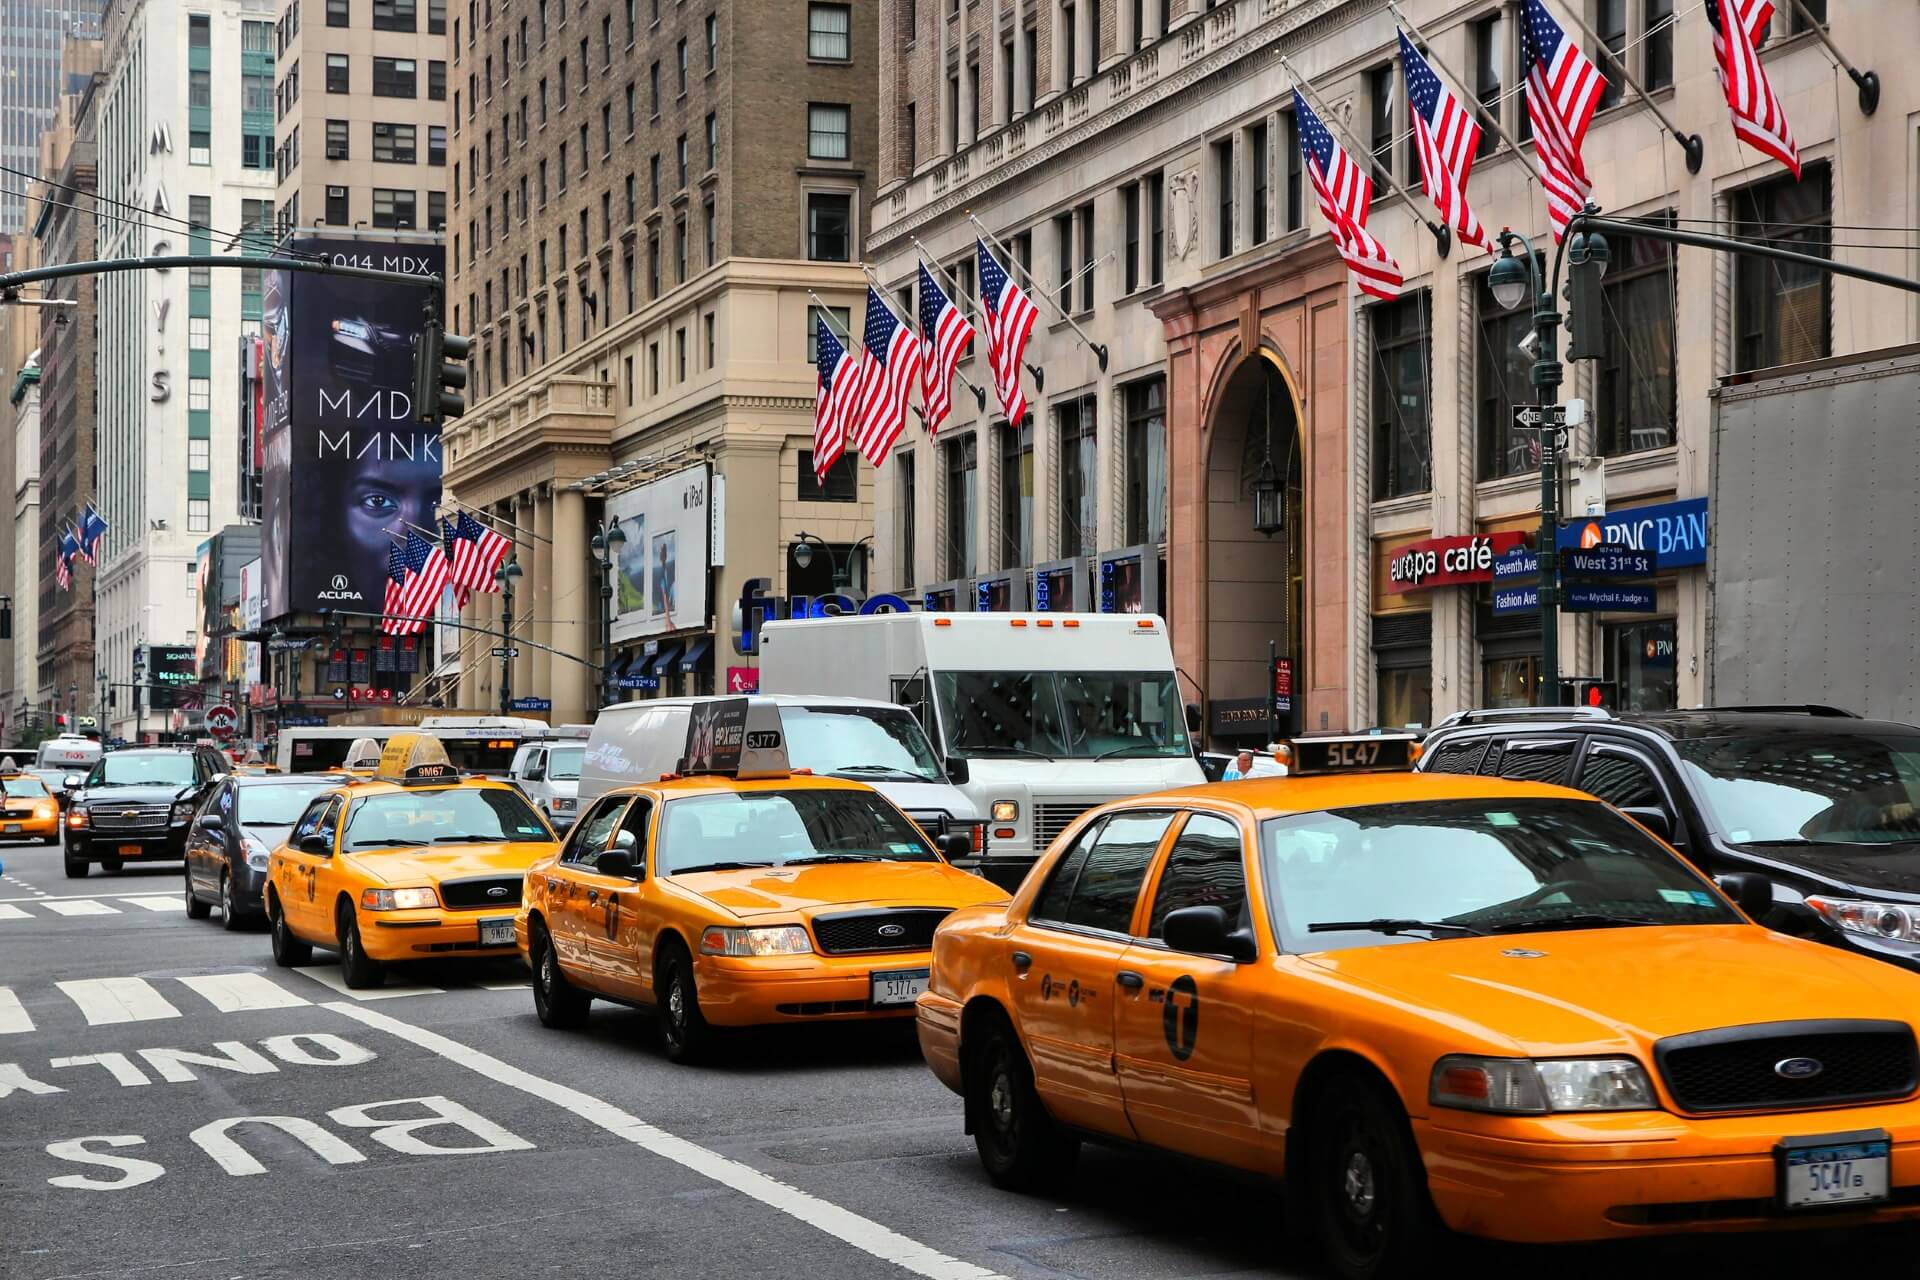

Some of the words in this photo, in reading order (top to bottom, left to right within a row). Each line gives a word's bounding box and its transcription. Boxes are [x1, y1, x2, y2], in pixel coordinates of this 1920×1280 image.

[321, 253, 373, 269] 014
[383, 256, 430, 274] MDX
[319, 388, 411, 420] MAD
[1522, 412, 1540, 421] ONE
[318, 430, 438, 463] MANK
[689, 481, 703, 509] iPad
[1656, 511, 1708, 554] BAN
[1391, 550, 1436, 585] europa
[1444, 537, 1492, 572] café
[1495, 557, 1523, 575] Seventh
[1523, 557, 1537, 571] Ave
[1574, 555, 1606, 570] West
[1609, 556, 1632, 571] 31st
[1634, 556, 1649, 571] St
[317, 591, 363, 600] ACURA
[1496, 592, 1522, 609] Fashion
[1523, 593, 1537, 605] Ave
[1589, 593, 1614, 603] Mychal
[1622, 594, 1642, 604] Judge
[618, 679, 634, 687] West
[367, 690, 374, 698] 2
[382, 690, 389, 698] 3
[748, 734, 777, 748] 5J77
[1327, 742, 1379, 766] 5C47
[418, 766, 444, 777] 9M67
[46, 1096, 538, 1191] BUS
